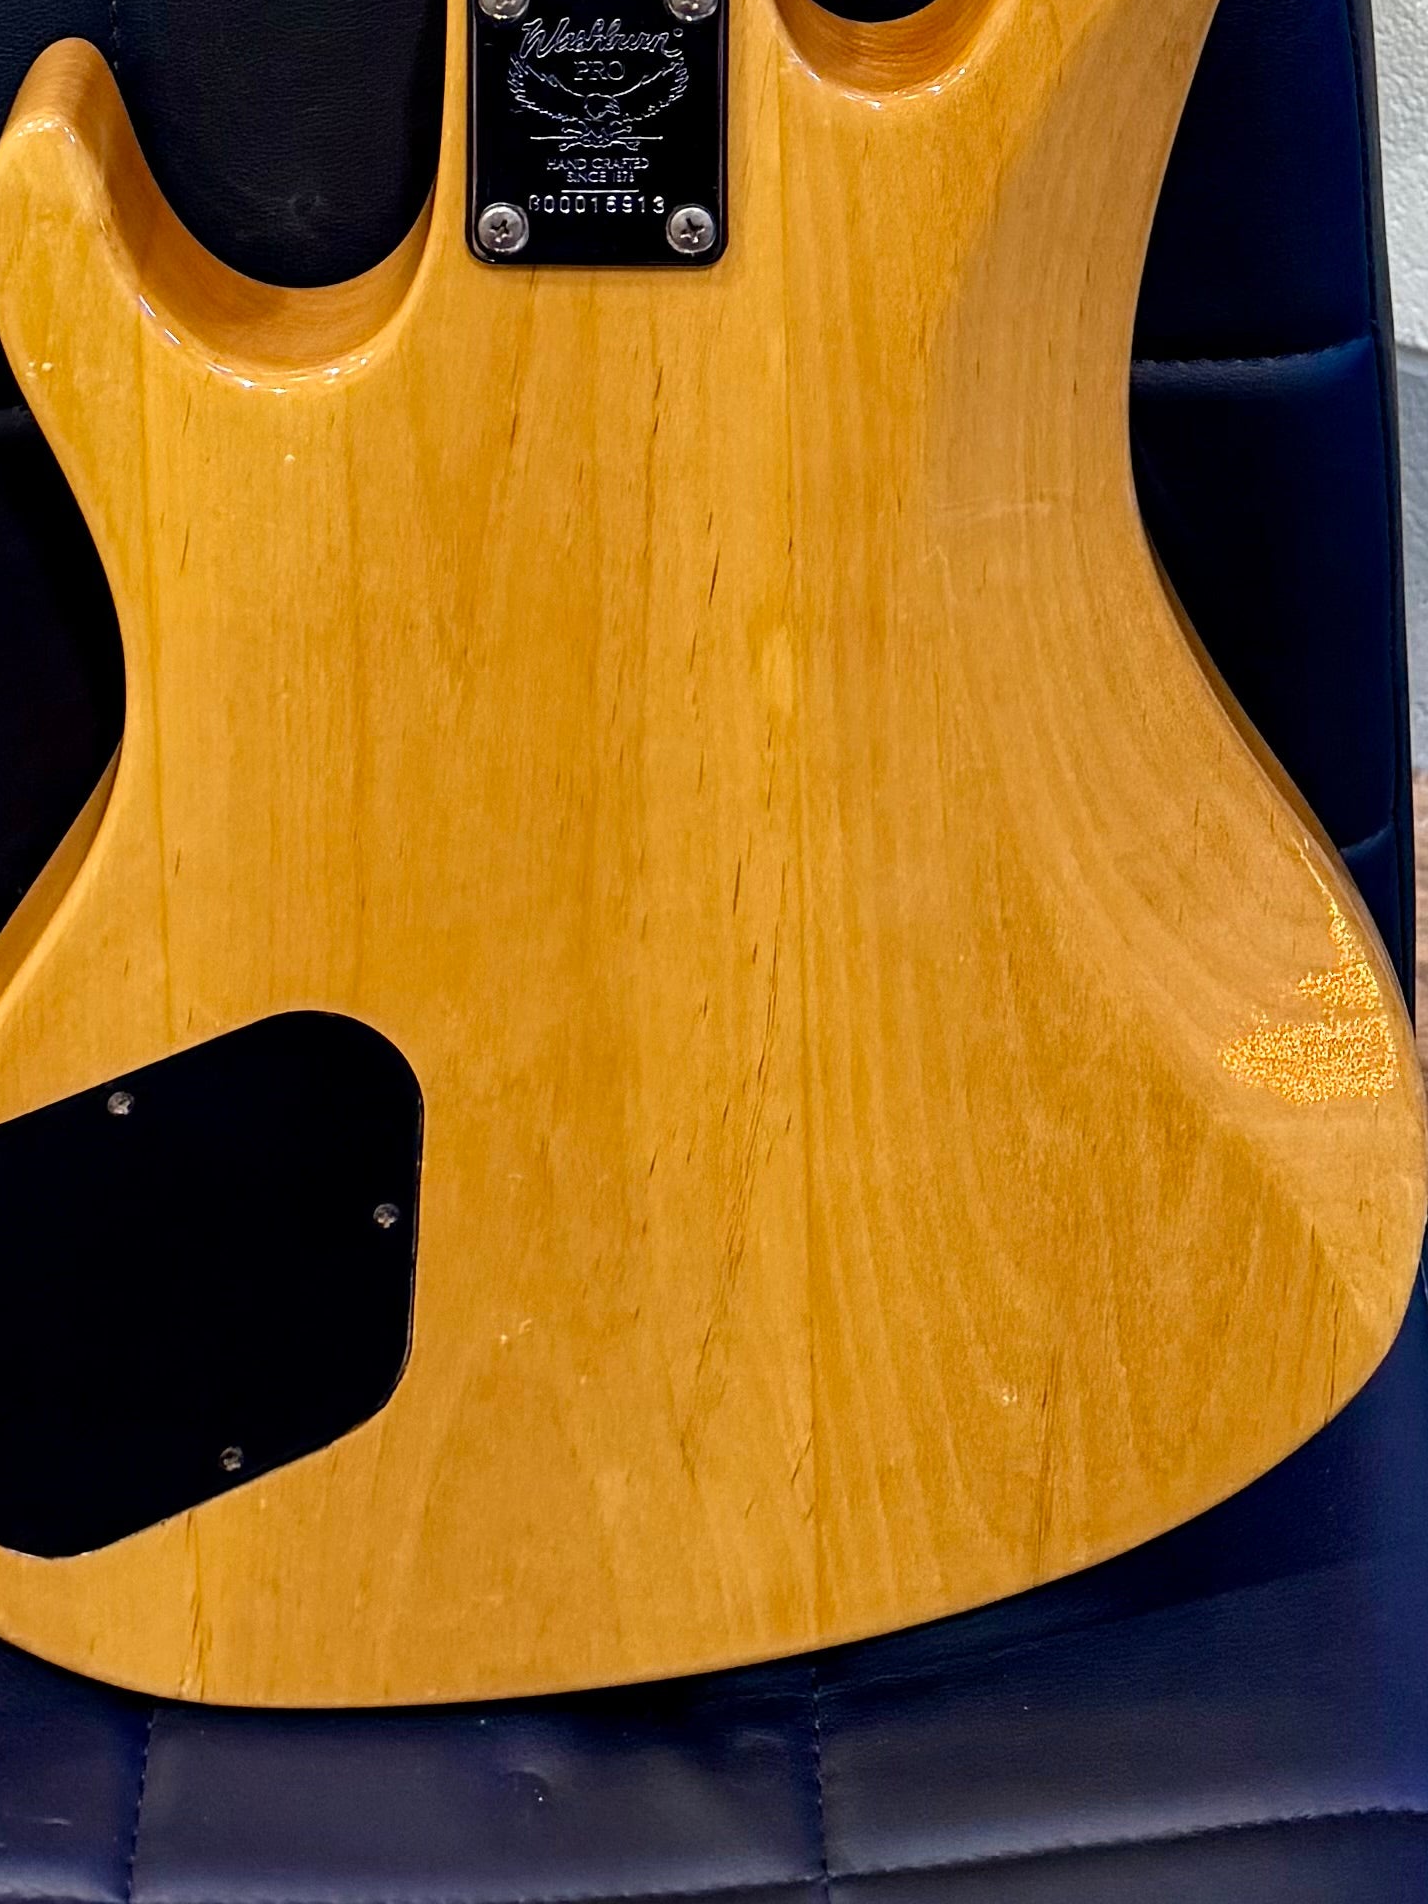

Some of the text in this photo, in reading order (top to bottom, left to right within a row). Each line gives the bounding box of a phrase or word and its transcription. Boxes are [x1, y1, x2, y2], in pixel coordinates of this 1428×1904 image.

[520, 17, 682, 59] Washburn
[574, 60, 625, 81] PRO
[546, 157, 650, 171] HAND CRAFTED
[566, 171, 607, 183] SINCE
